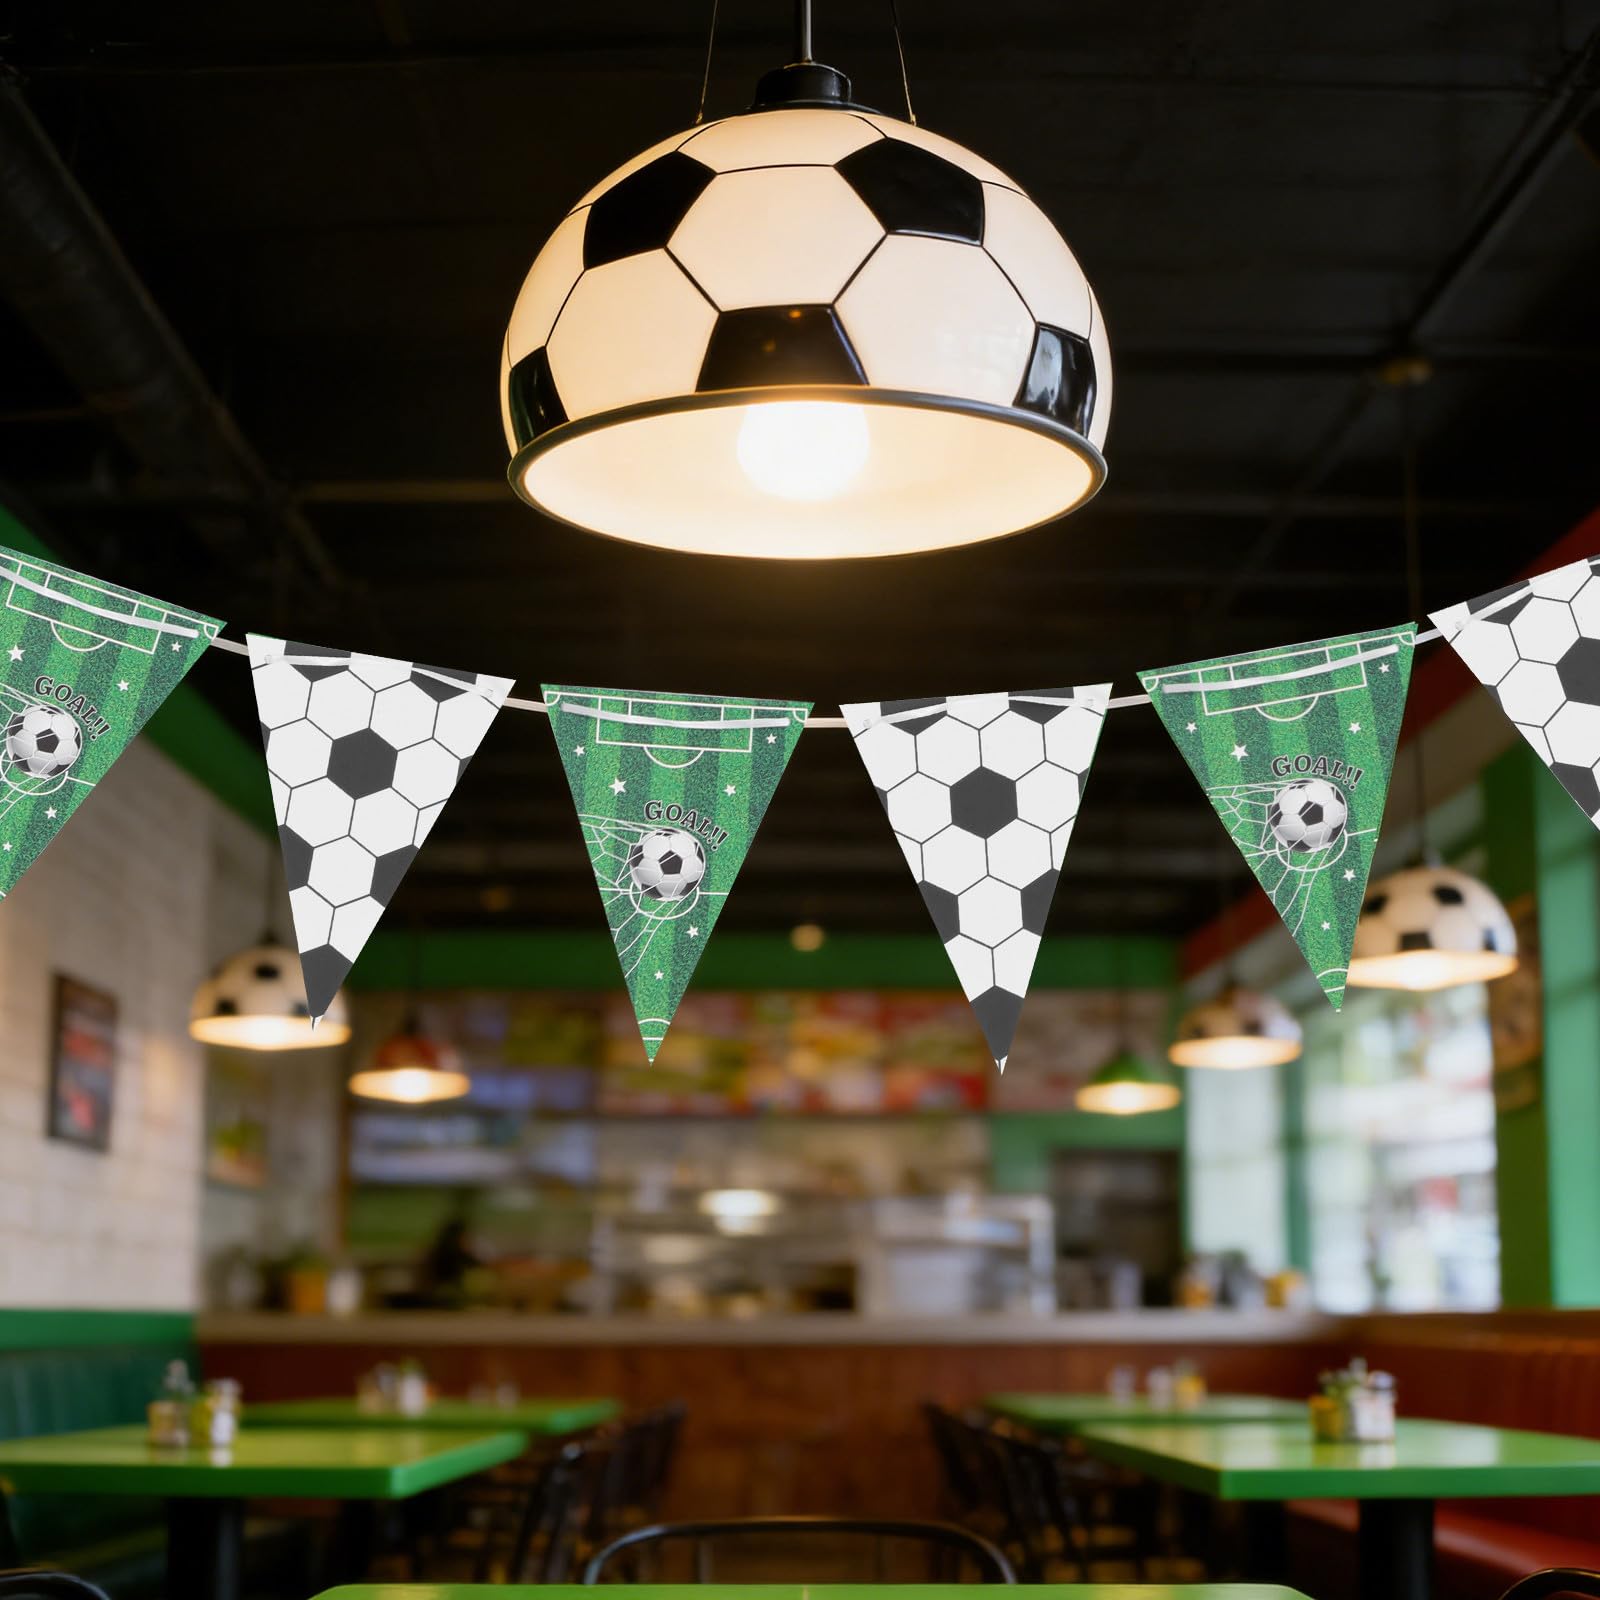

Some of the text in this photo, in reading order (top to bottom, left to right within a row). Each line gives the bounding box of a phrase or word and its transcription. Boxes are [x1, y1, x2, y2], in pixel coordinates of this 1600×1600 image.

[34, 676, 111, 741] GOAL!!
[1271, 753, 1364, 791] GOAL!!
[644, 800, 729, 851] GOAL!!
